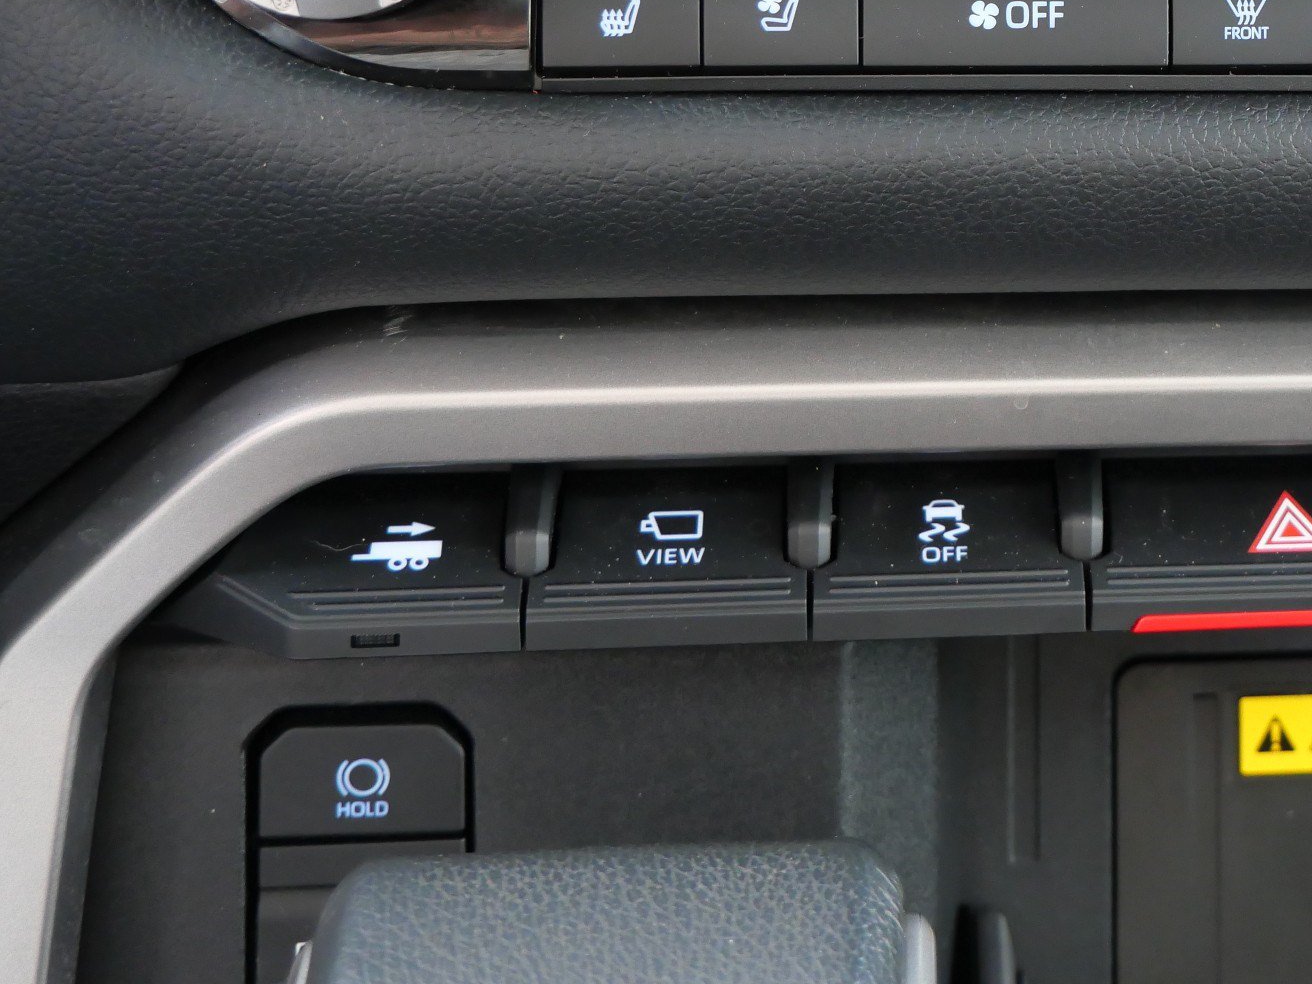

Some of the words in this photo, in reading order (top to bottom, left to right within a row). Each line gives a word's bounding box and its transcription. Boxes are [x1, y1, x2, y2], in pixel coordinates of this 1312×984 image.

[1005, 0, 1065, 30] OFF
[1224, 26, 1270, 41] FRONT
[636, 547, 706, 566] VIEW
[921, 545, 968, 564] OFF
[335, 800, 389, 819] HOLD
